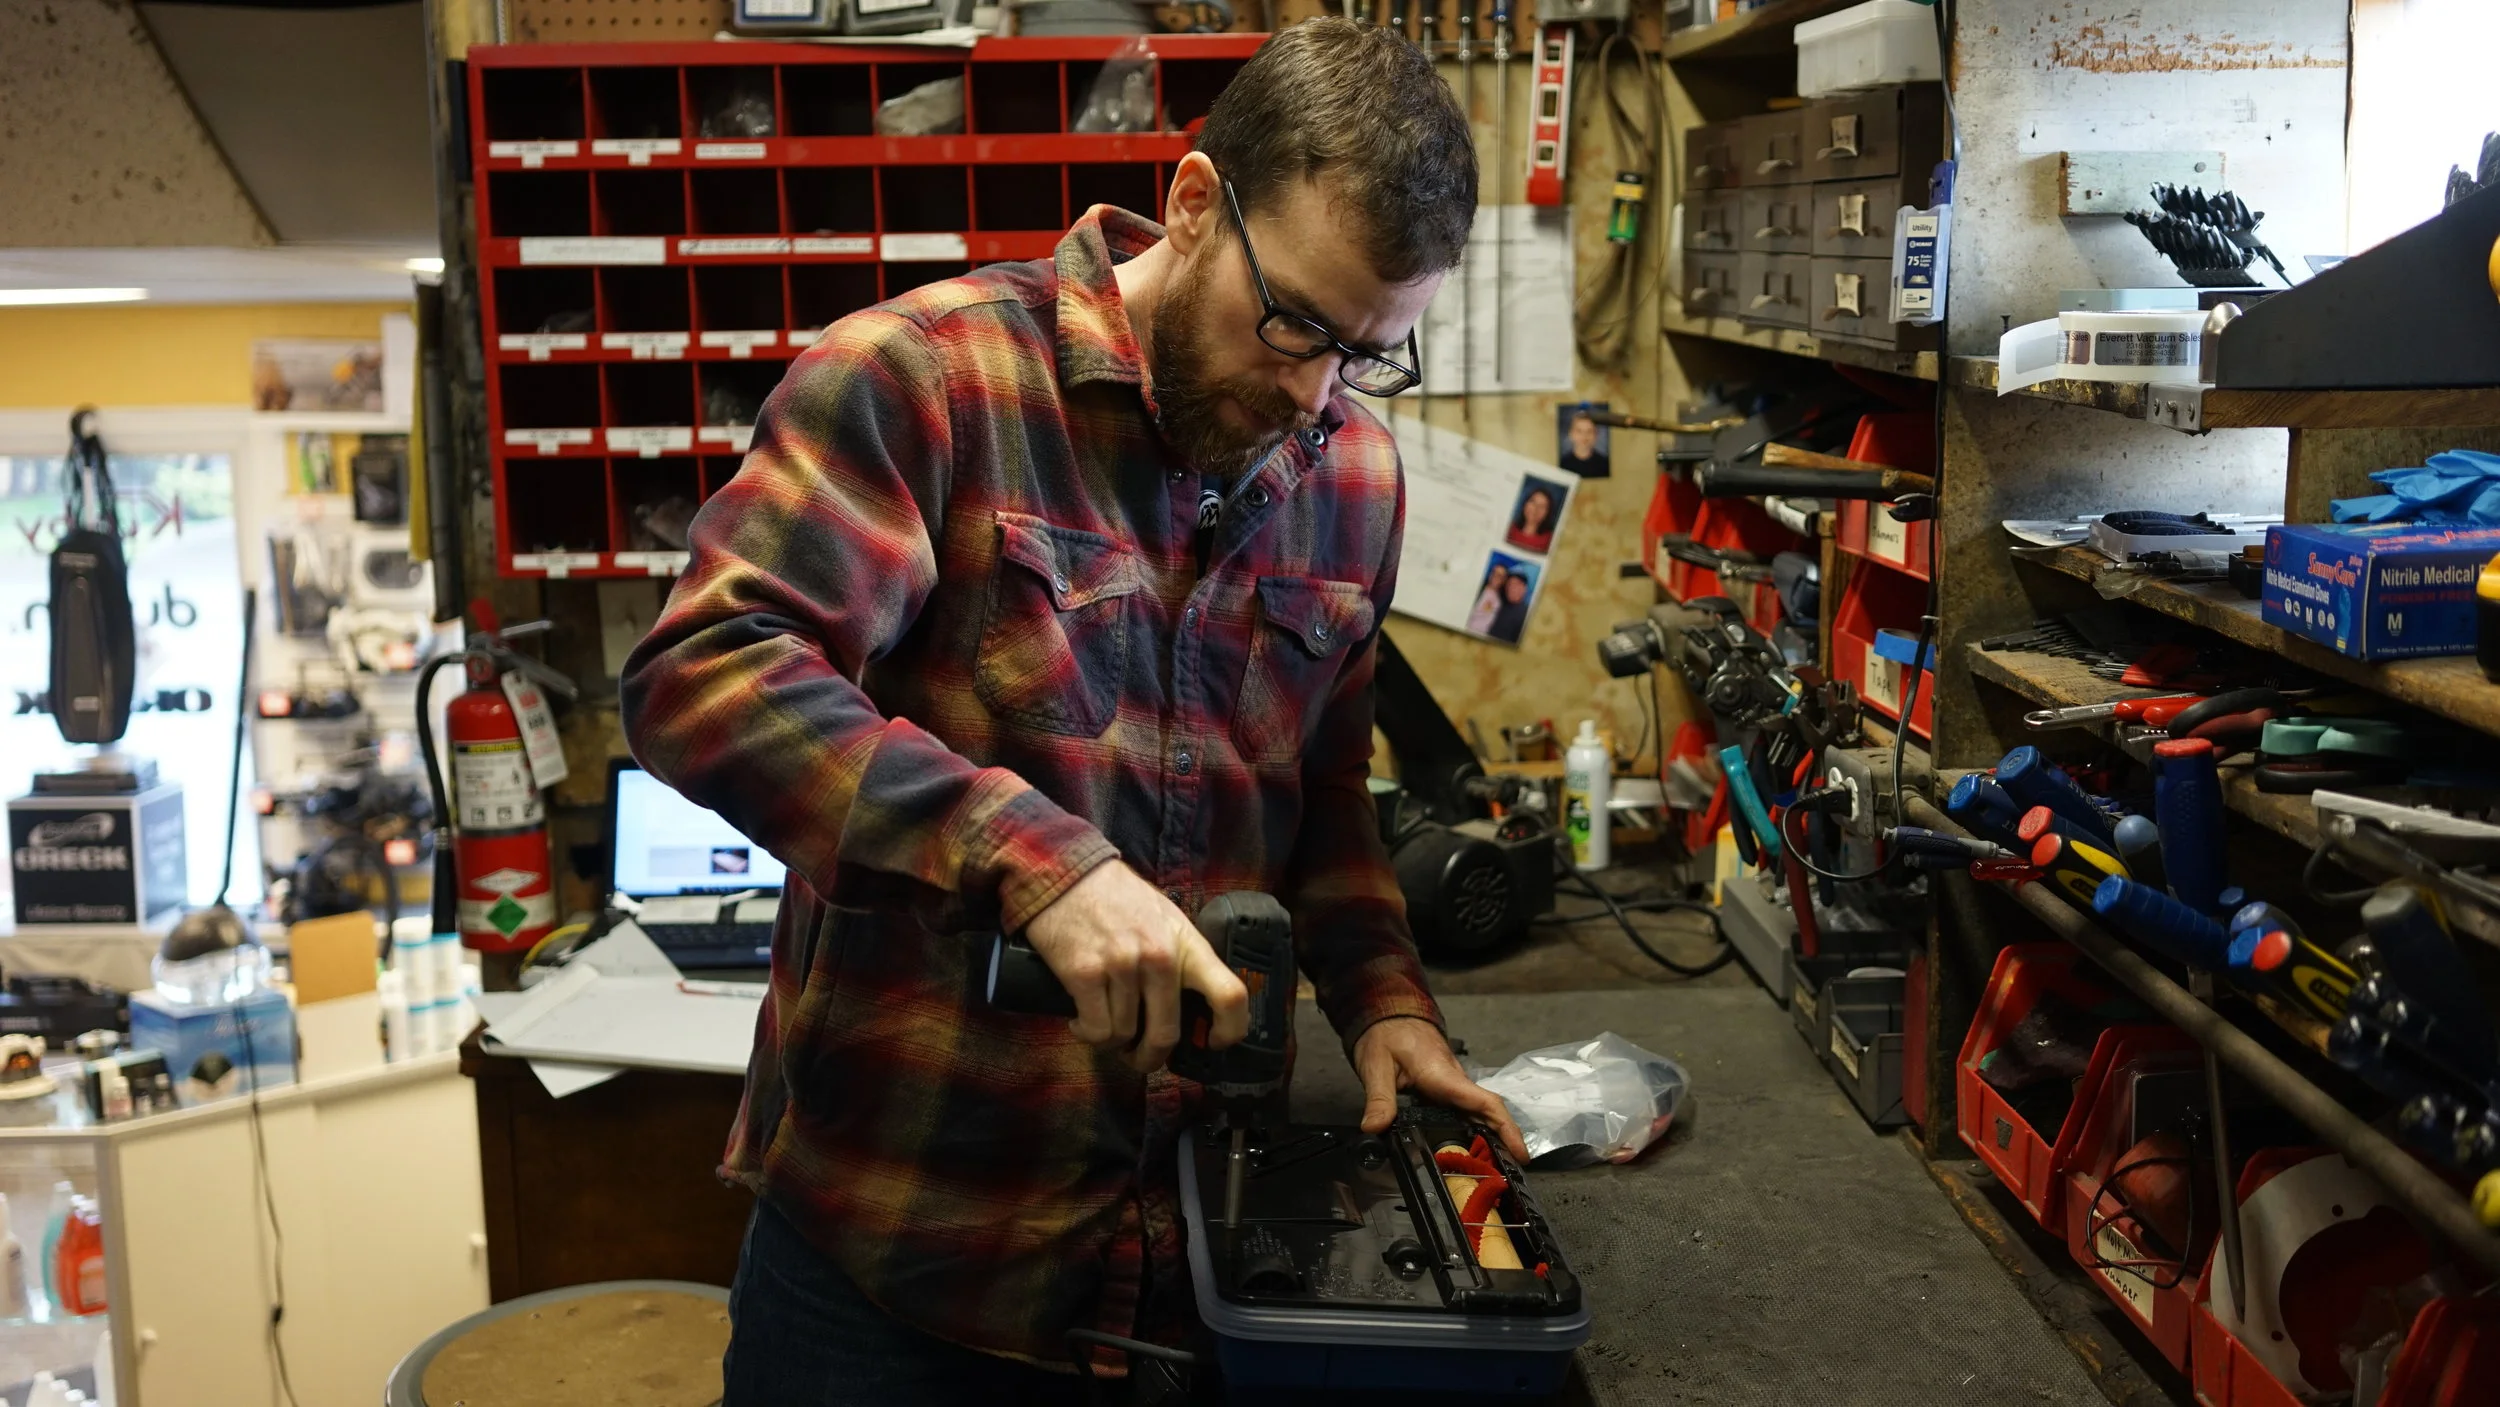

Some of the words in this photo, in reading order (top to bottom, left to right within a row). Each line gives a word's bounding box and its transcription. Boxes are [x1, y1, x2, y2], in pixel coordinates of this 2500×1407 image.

[1907, 256, 1920, 266] 75
[2099, 333, 2133, 342] Everett
[2136, 333, 2176, 342] Vacuum
[2178, 333, 2201, 342] Sales
[2308, 552, 2356, 588] SunnyCare
[2381, 567, 2421, 587] Nitrile
[2424, 563, 2475, 585] Medical
[2277, 571, 2292, 592] Medical
[2305, 606, 2313, 625] M
[2387, 612, 2403, 631] M
[2105, 1226, 2121, 1254] Volt
